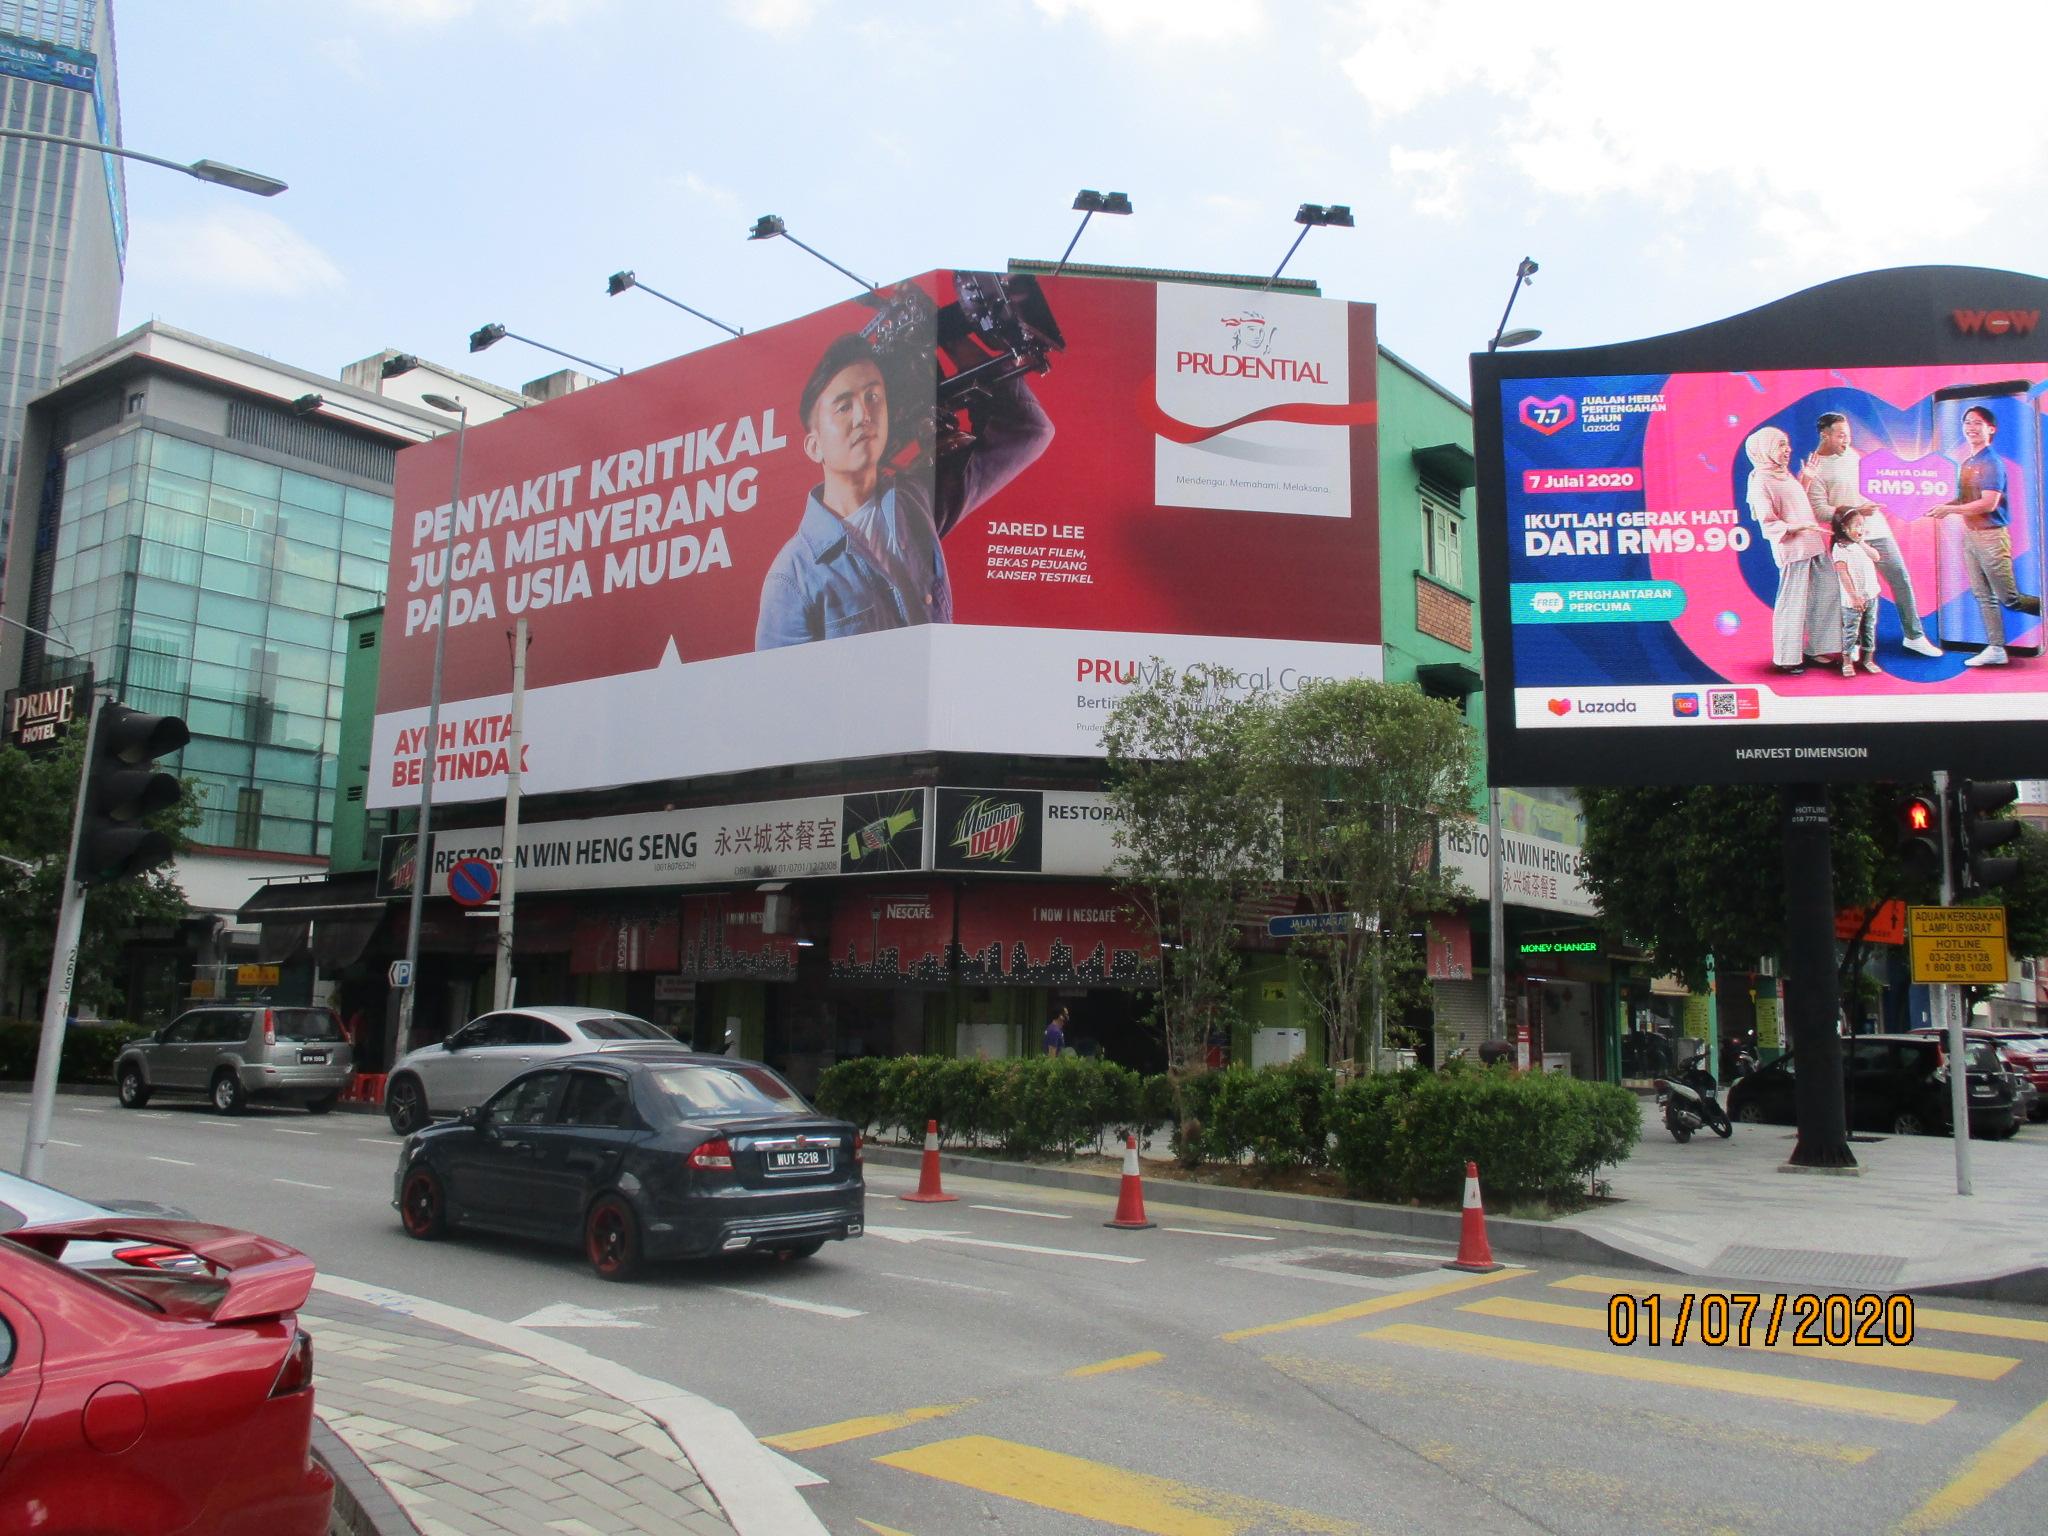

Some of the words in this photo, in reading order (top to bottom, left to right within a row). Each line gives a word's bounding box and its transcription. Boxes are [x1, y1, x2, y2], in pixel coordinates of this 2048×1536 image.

[1952, 310, 2041, 334] WOW
[1176, 351, 1329, 384] PRUDENTIAL
[1581, 396, 1626, 405] JUALAN
[1628, 394, 1665, 404] HEBAT
[1581, 403, 1667, 414] PERTENGAHAN
[1534, 408, 1561, 425] 7.7
[1581, 413, 1622, 423] TAHUN
[1582, 422, 1620, 433] Lazada
[412, 464, 582, 548] PENYAKIT
[589, 407, 787, 500] KRITIKAL
[1529, 475, 1541, 488] 7
[1544, 473, 1584, 488] Julai
[1586, 473, 1634, 487] 2020
[1875, 468, 1913, 478] HANYA
[1914, 468, 1938, 478] DARI
[1176, 475, 1228, 489] Mendengar.
[1230, 478, 1281, 490] Memahami.
[1867, 479, 1949, 497] RM9.90
[1524, 512, 1613, 530] IKUTLAH
[1616, 510, 1687, 527] GERAK
[1691, 509, 1738, 525] HATI
[406, 536, 495, 594] JUGA
[504, 466, 759, 570] MENYERANG
[987, 521, 1048, 537] JARED
[1052, 524, 1085, 540] LEE
[1525, 529, 1610, 557] DARI
[1617, 526, 1750, 555] RM9.90
[987, 544, 1047, 557] PEMBUAT
[1048, 547, 1087, 560] FILEM,
[987, 557, 1028, 568] BEKAS
[1031, 560, 1088, 571] PEJUANG
[404, 582, 496, 637] PADA
[506, 560, 593, 614] USIA
[602, 527, 733, 595] MUDA
[987, 570, 1037, 581] KANSER
[1039, 572, 1094, 584] TESTIKEL
[1536, 598, 1560, 607] FREE
[1569, 589, 1672, 601] PENGHANTARAN
[1569, 602, 1632, 613] PERCUMA
[9, 685, 75, 733] PRIME
[1577, 698, 1637, 714] Lazada
[22, 723, 56, 744] HOTEL
[1736, 748, 1791, 759] HARVEST
[1794, 747, 1868, 759] DIMENSION
[1048, 805, 1126, 820] RESTORA
[714, 817, 837, 857] 永兴城茶餐室
[434, 845, 529, 873] RESTORN
[532, 840, 571, 867] WIN
[575, 836, 633, 864] HENG
[639, 831, 698, 861] SENG
[1447, 830, 1515, 863] RESTOAN
[1517, 842, 1540, 869] WIN
[1542, 848, 1571, 875] HENG
[1040, 908, 1063, 922] NOW
[1915, 911, 1946, 921] ADUAN
[1947, 912, 2001, 922] KEROSAKAN
[1290, 918, 1318, 928] JALAN
[1922, 923, 1953, 932] LAMPU
[1955, 923, 1992, 933] ISYARAT
[1521, 944, 1552, 953] MONEY
[1553, 943, 1597, 952] CHANGER
[1936, 940, 1981, 949] HOTLINE
[777, 1153, 795, 1166] WUY
[797, 1152, 819, 1165] 5218
